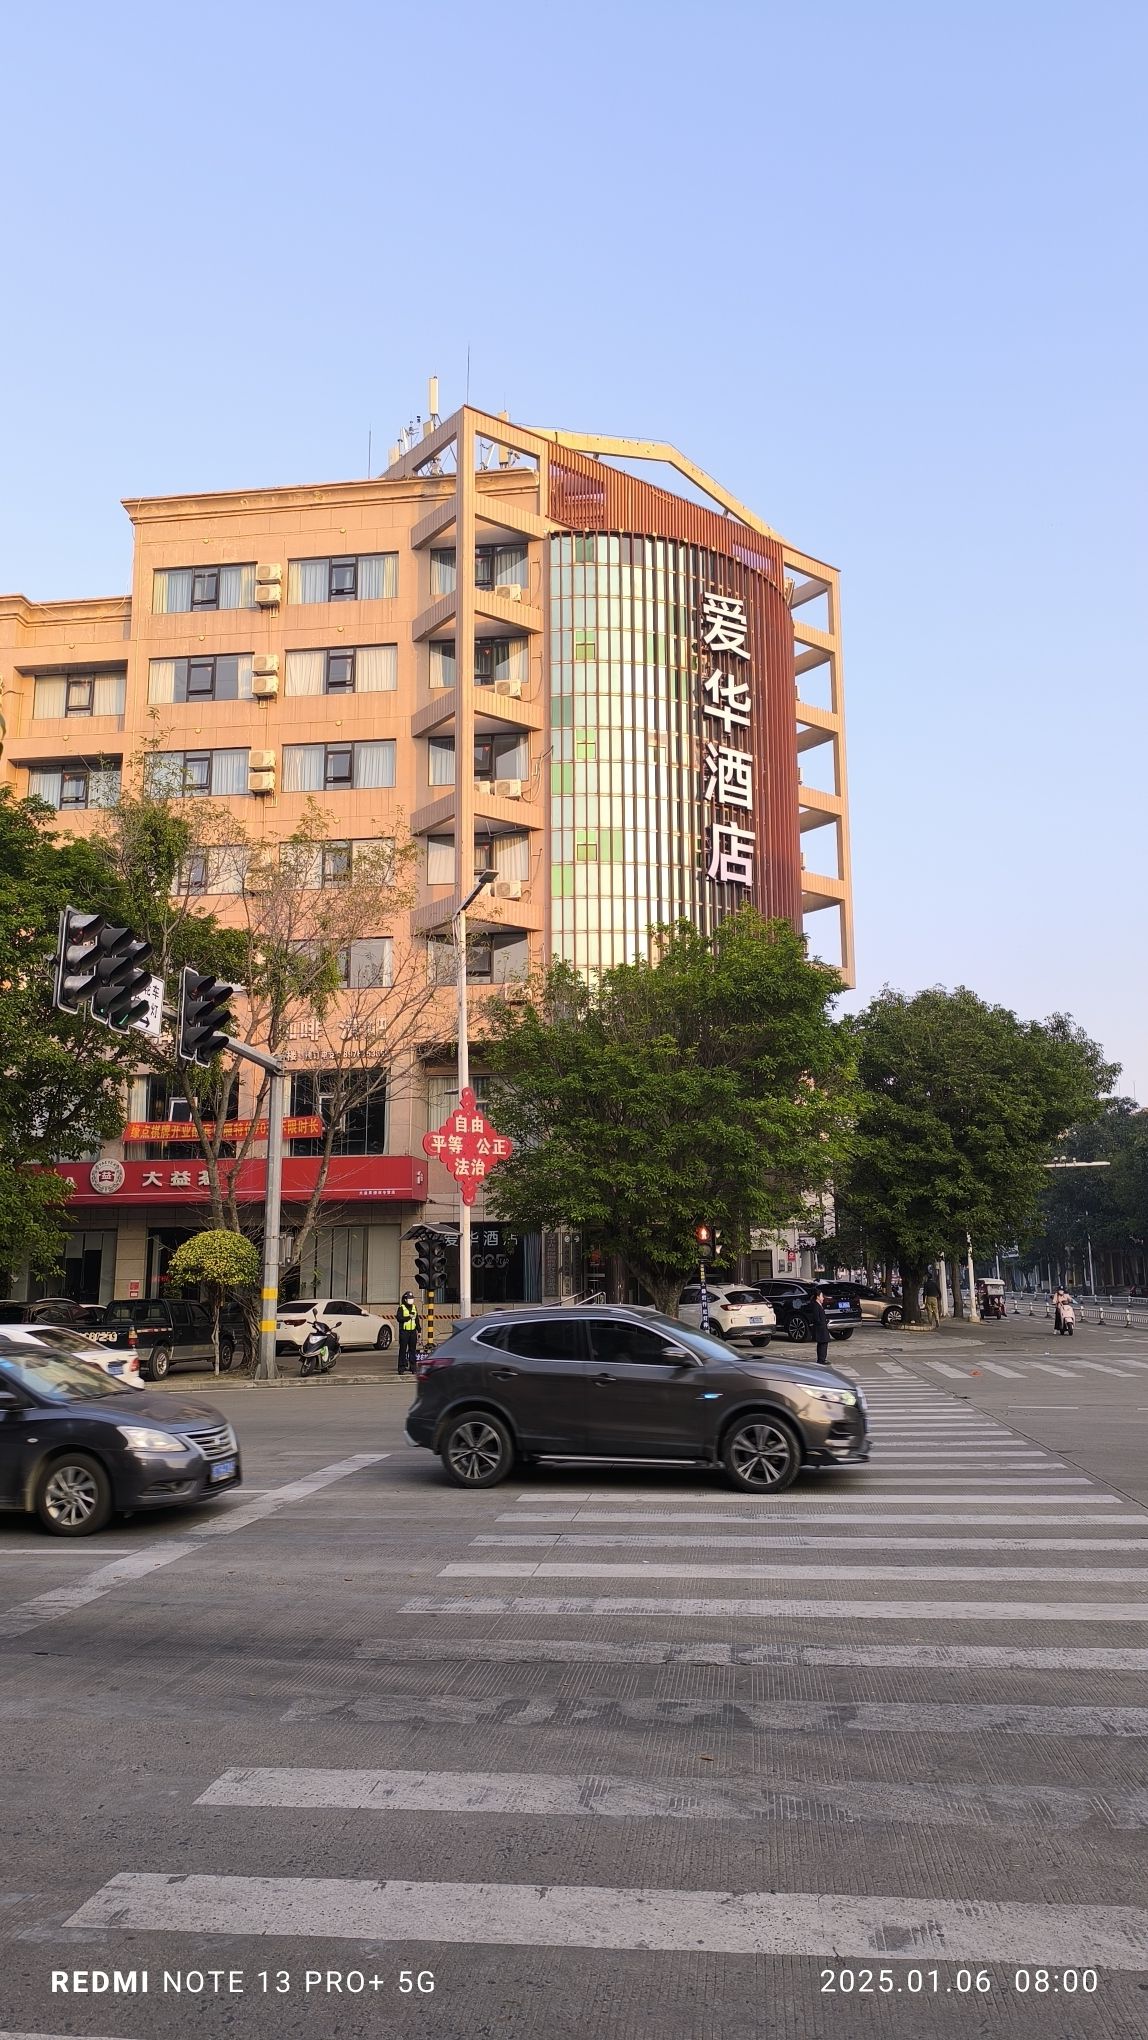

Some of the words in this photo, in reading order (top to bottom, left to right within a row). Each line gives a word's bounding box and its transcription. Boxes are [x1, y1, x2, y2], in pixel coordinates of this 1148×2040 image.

[702, 591, 756, 888] 爱华酒店
[455, 1115, 484, 1134] 自由
[431, 1134, 463, 1154] 平等
[476, 1138, 506, 1155] 公正
[455, 1158, 486, 1176] 法治
